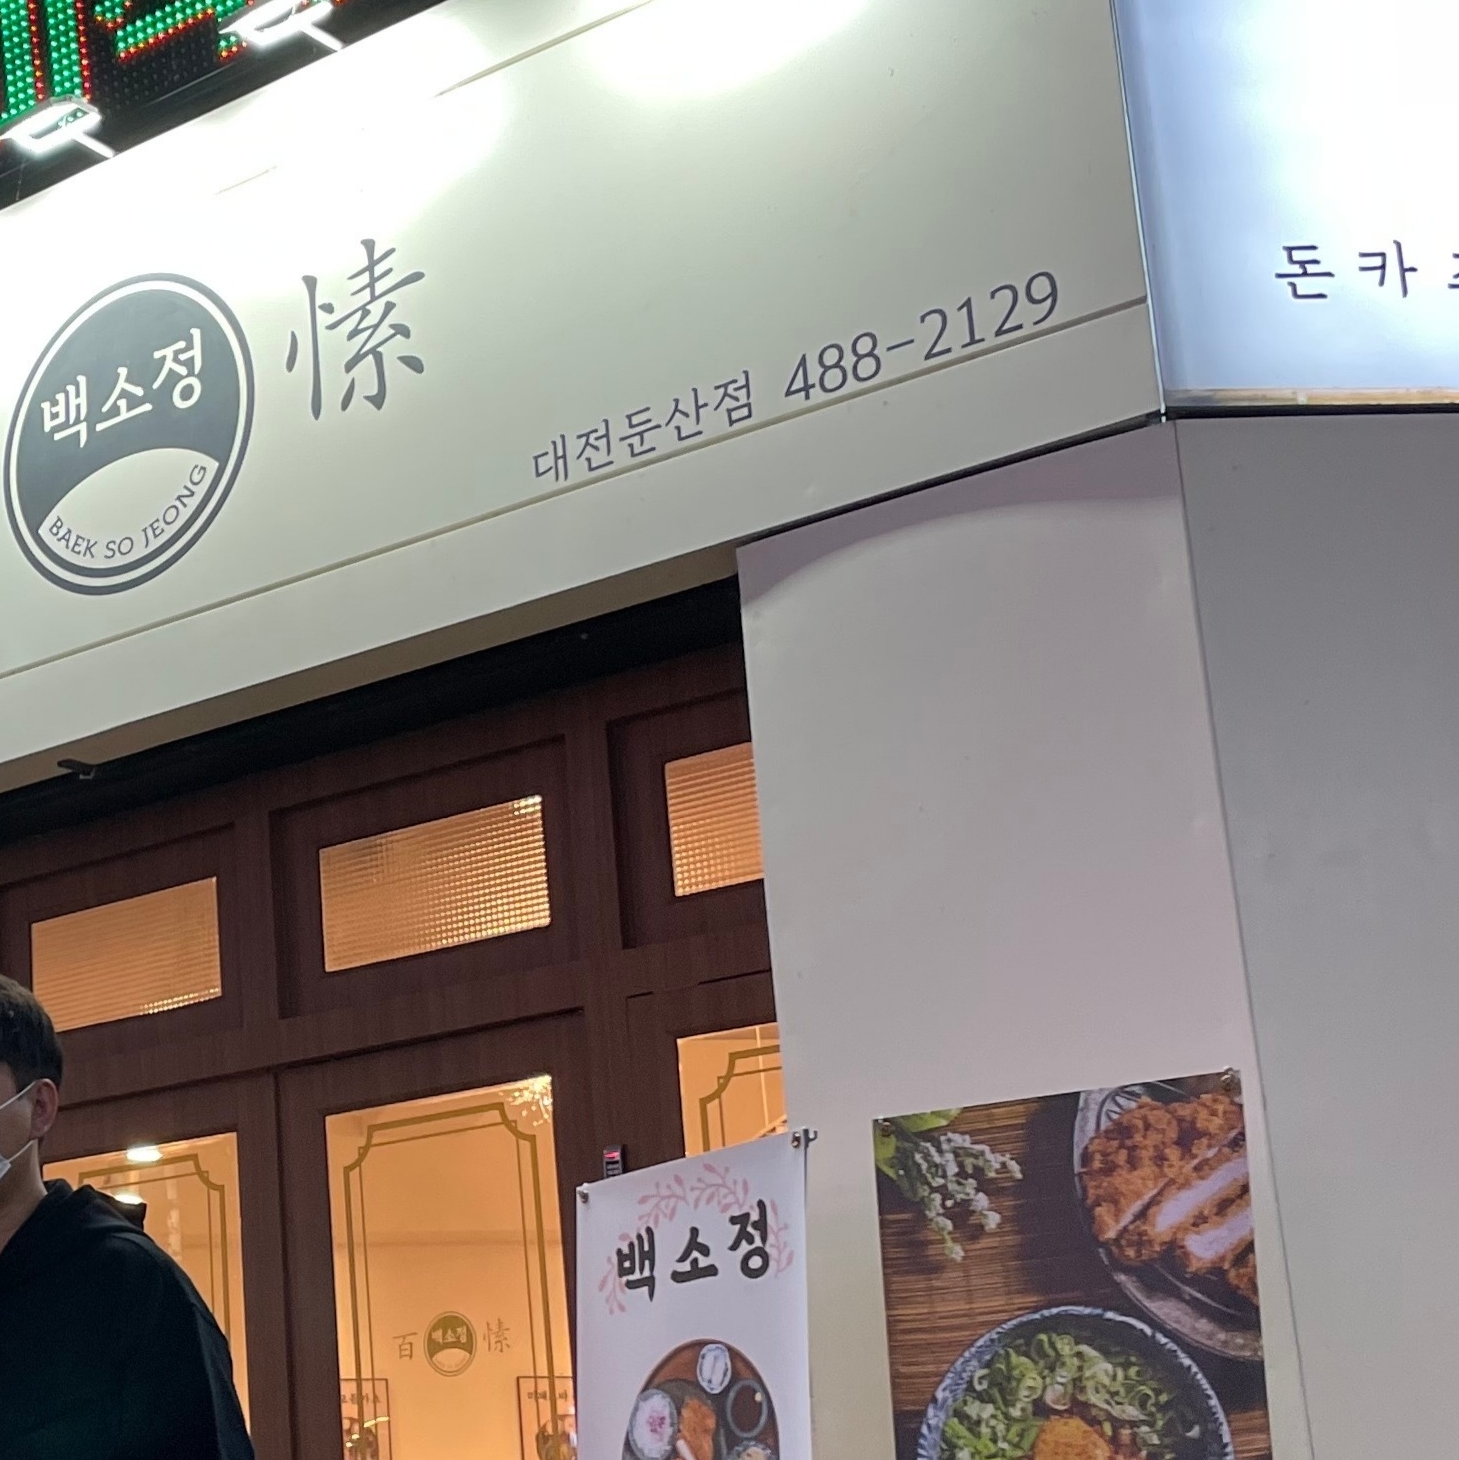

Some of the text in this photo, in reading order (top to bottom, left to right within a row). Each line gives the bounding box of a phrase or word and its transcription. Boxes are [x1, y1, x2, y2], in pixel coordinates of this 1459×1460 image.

[39, 326, 205, 449] 백소정
[531, 270, 1059, 483] 대전둔산점 488-2129
[48, 463, 208, 560] BAEK SO JEONG
[616, 1198, 771, 1303] 백소정
[392, 1332, 418, 1360] 百
